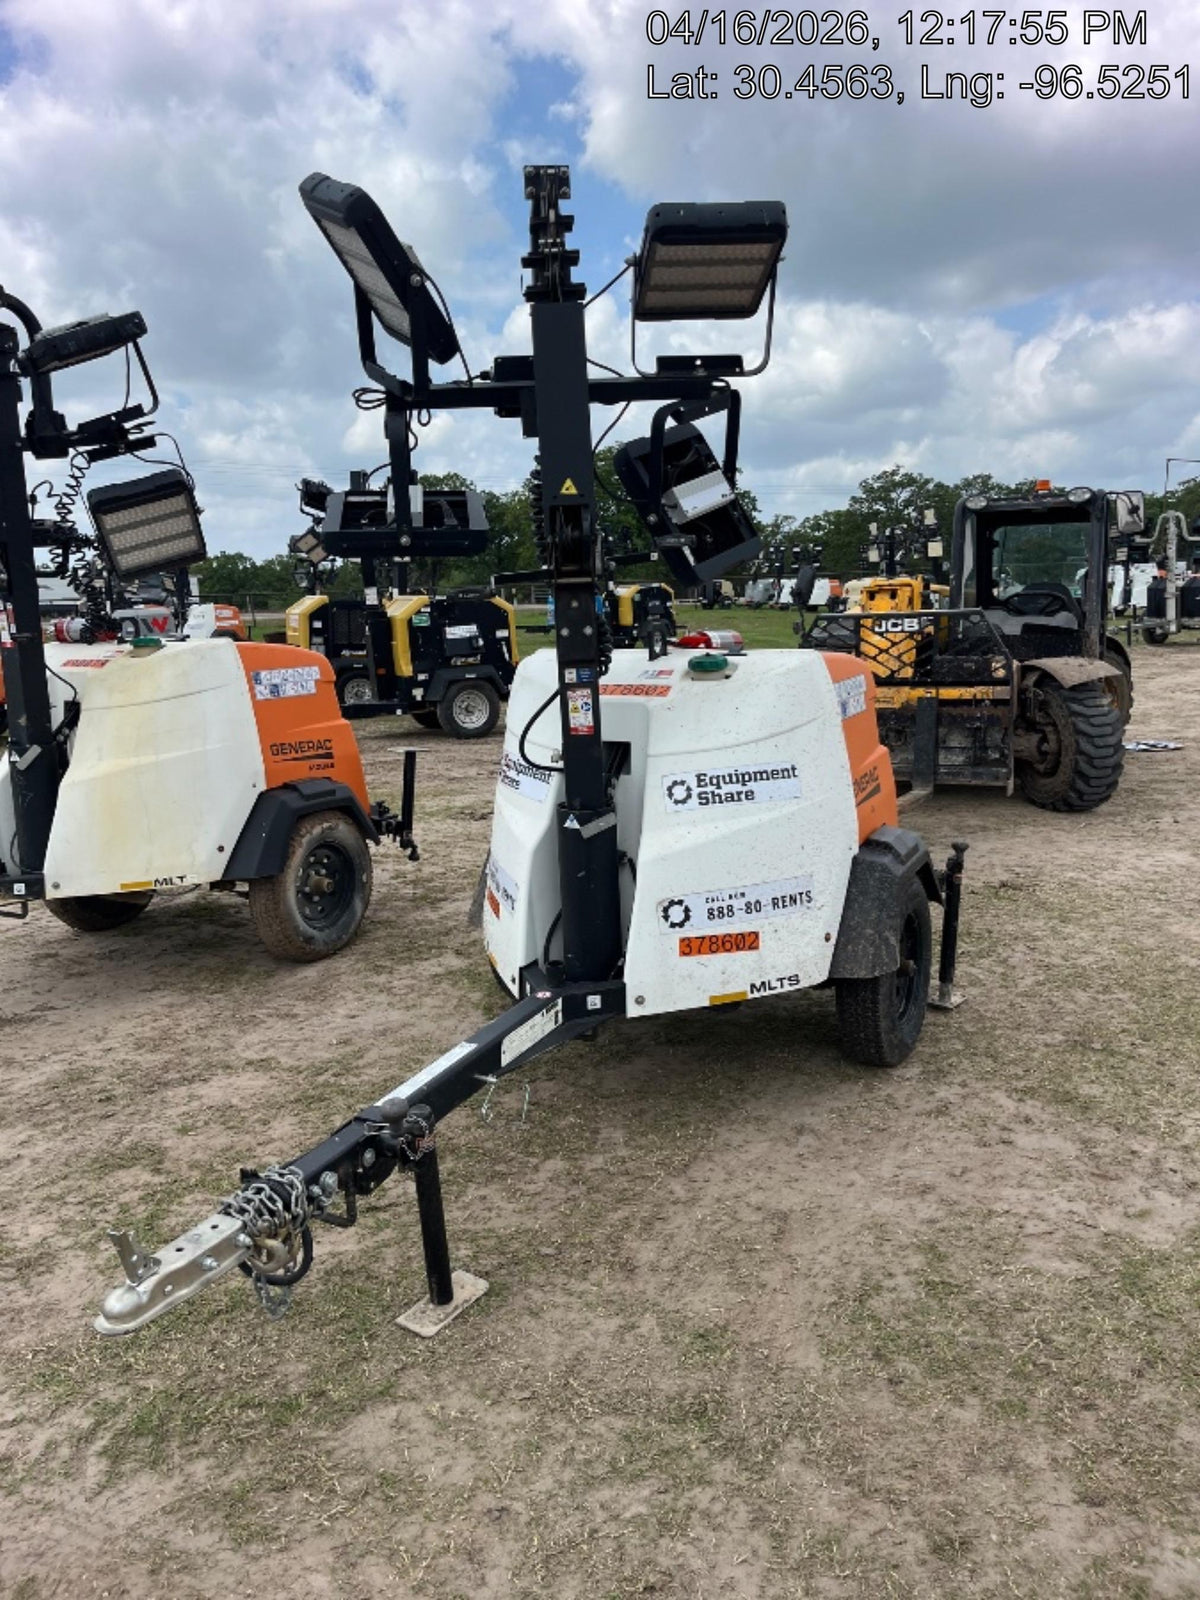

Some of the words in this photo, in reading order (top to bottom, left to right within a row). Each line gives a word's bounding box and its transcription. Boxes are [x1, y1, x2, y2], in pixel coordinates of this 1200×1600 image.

[874, 618, 920, 632] JCB
[269, 739, 333, 756] GENERAC
[695, 764, 799, 790] Equipment
[697, 789, 755, 806] Share
[680, 931, 760, 956] 378602
[750, 974, 800, 994] MLTS
